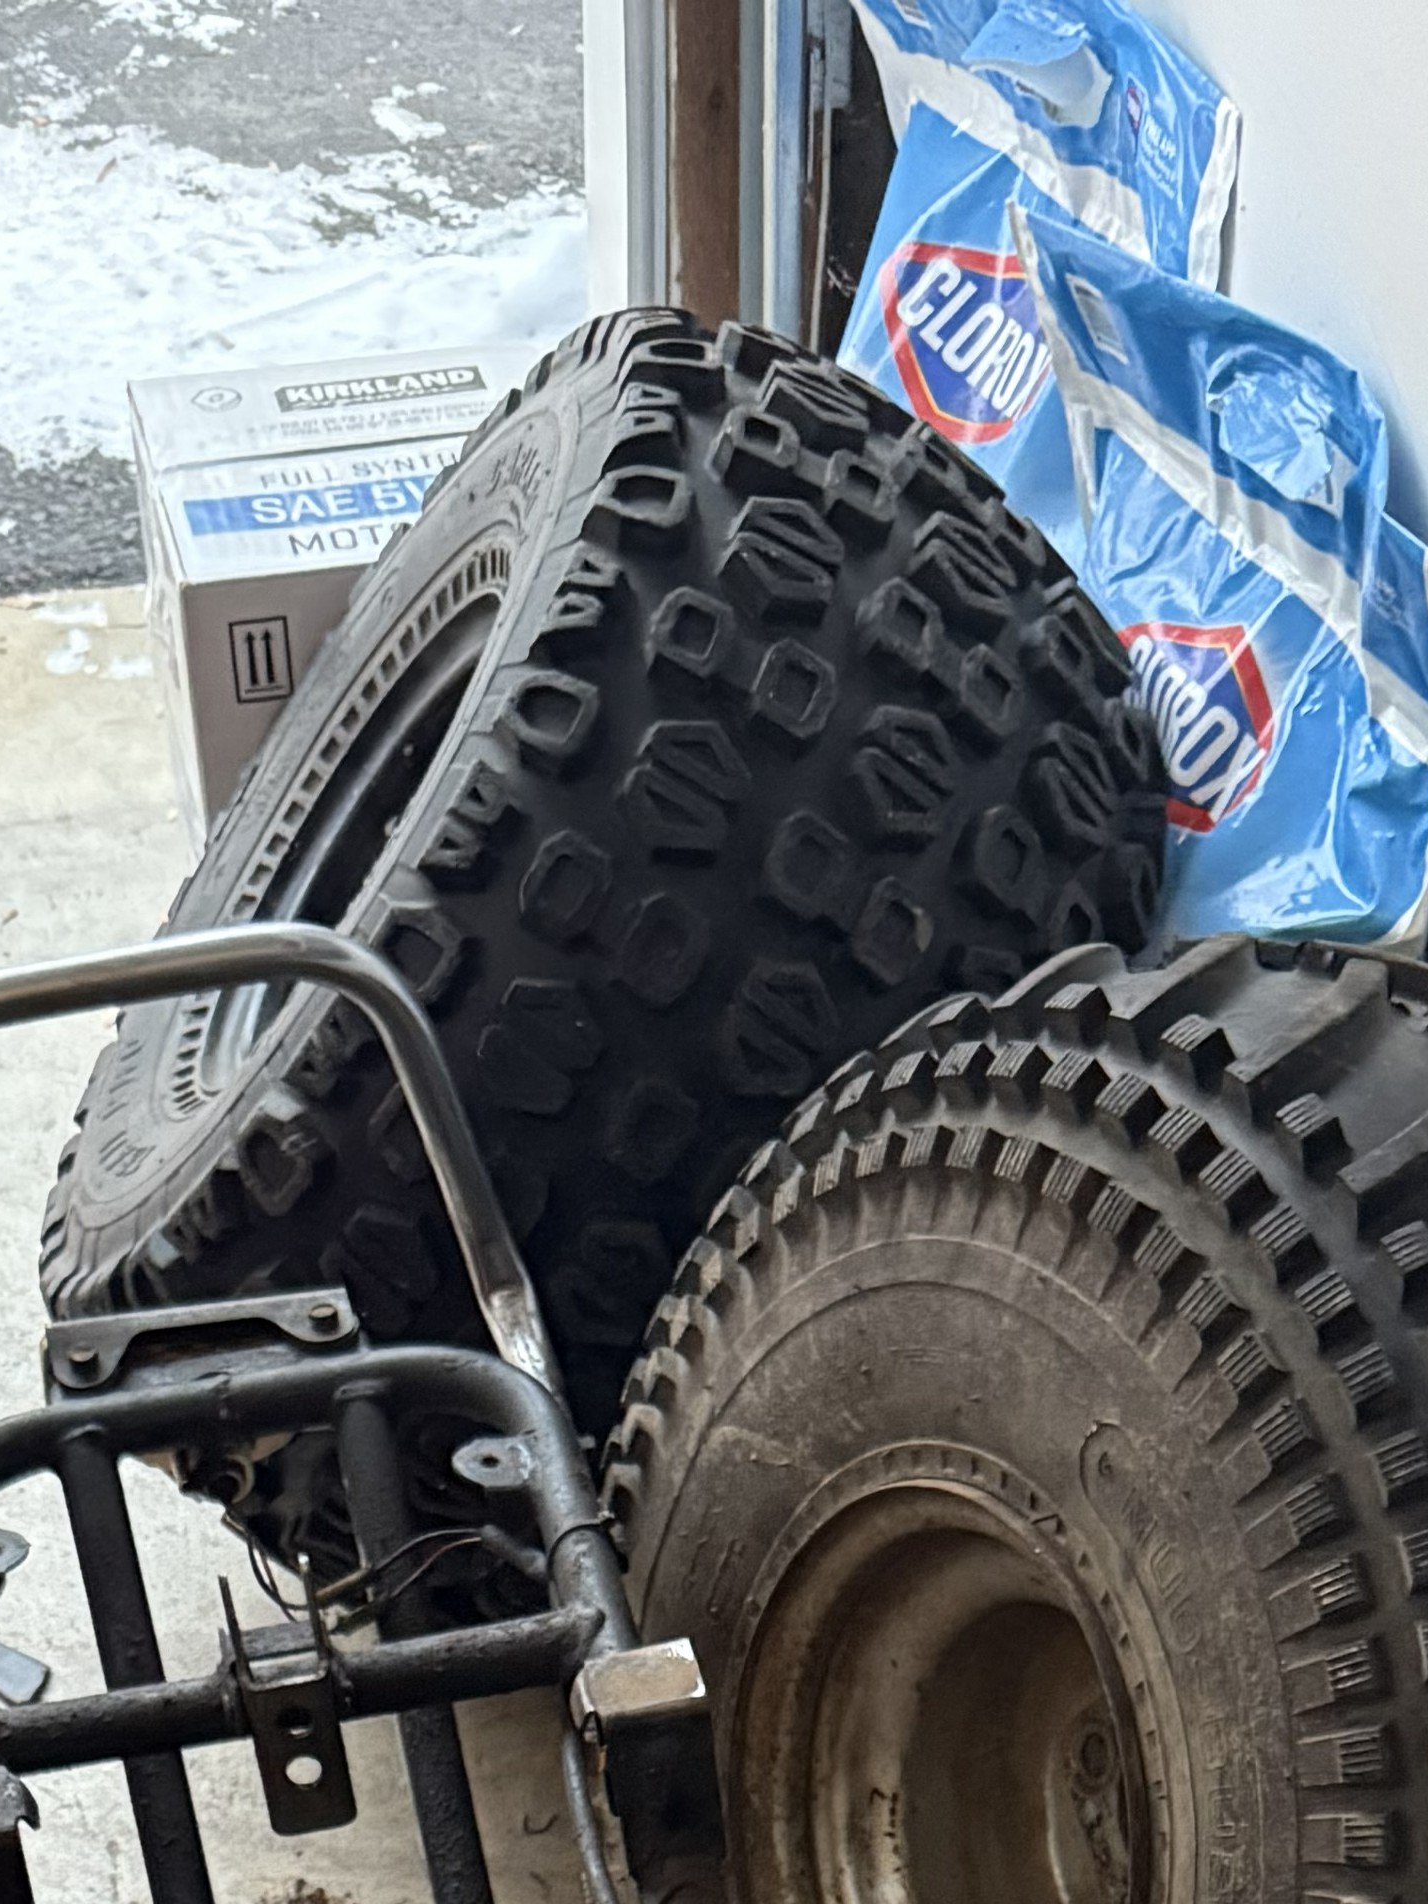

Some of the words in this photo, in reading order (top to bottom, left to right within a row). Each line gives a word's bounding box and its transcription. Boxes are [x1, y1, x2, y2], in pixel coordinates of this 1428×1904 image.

[896, 257, 1052, 422] CLOROX
[284, 369, 475, 404] KIRKLAND
[260, 465, 336, 490] FULL
[251, 488, 360, 524] SAE
